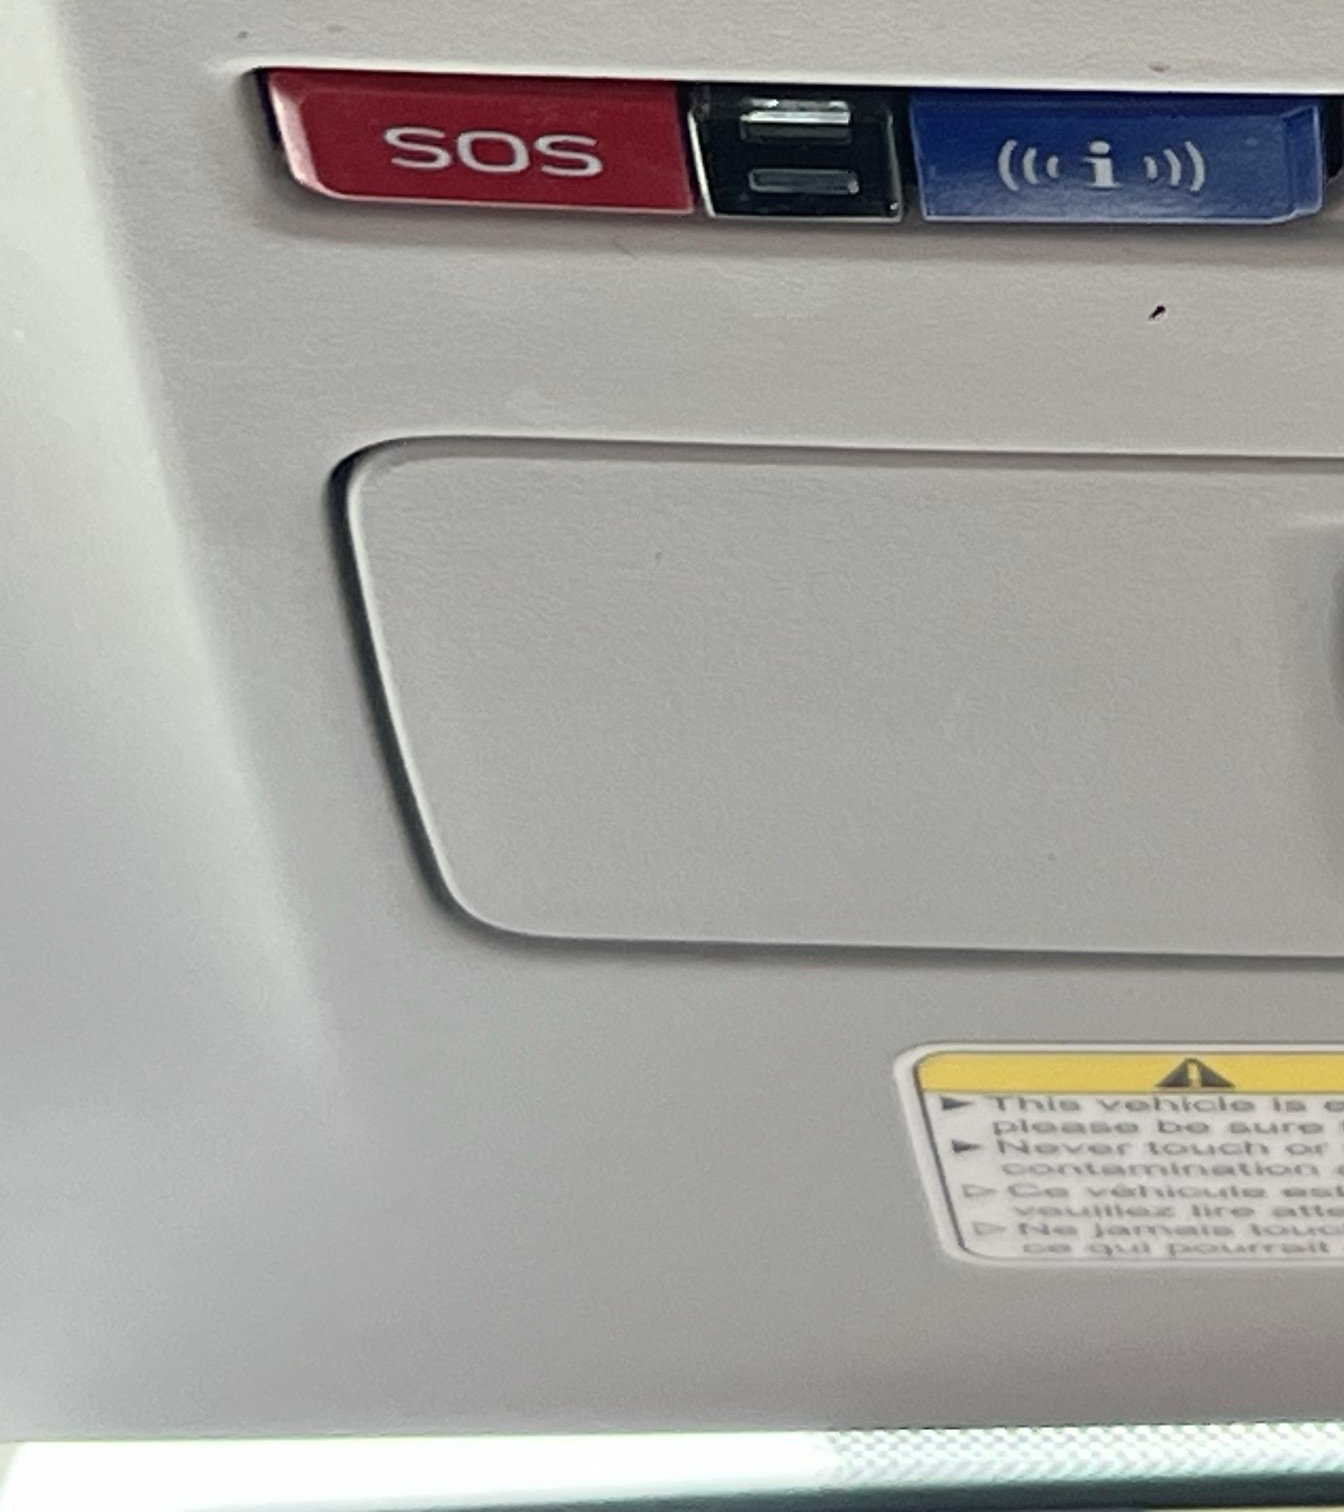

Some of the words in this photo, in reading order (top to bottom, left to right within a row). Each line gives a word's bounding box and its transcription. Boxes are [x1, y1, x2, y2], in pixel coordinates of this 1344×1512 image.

[383, 125, 605, 178] SOS
[984, 1094, 1080, 1112] This
[1098, 1095, 1254, 1112] vehicle
[1273, 1095, 1306, 1112] is
[993, 1119, 1139, 1137] please
[1158, 1119, 1209, 1135] be
[1229, 1122, 1323, 1135] sure
[997, 1139, 1134, 1156] Never
[1148, 1140, 1270, 1156] touch
[1285, 1141, 1330, 1156] or
[1002, 1162, 1320, 1178] contamination
[1008, 1183, 1069, 1199] Ce
[1085, 1183, 1266, 1199] véhicule
